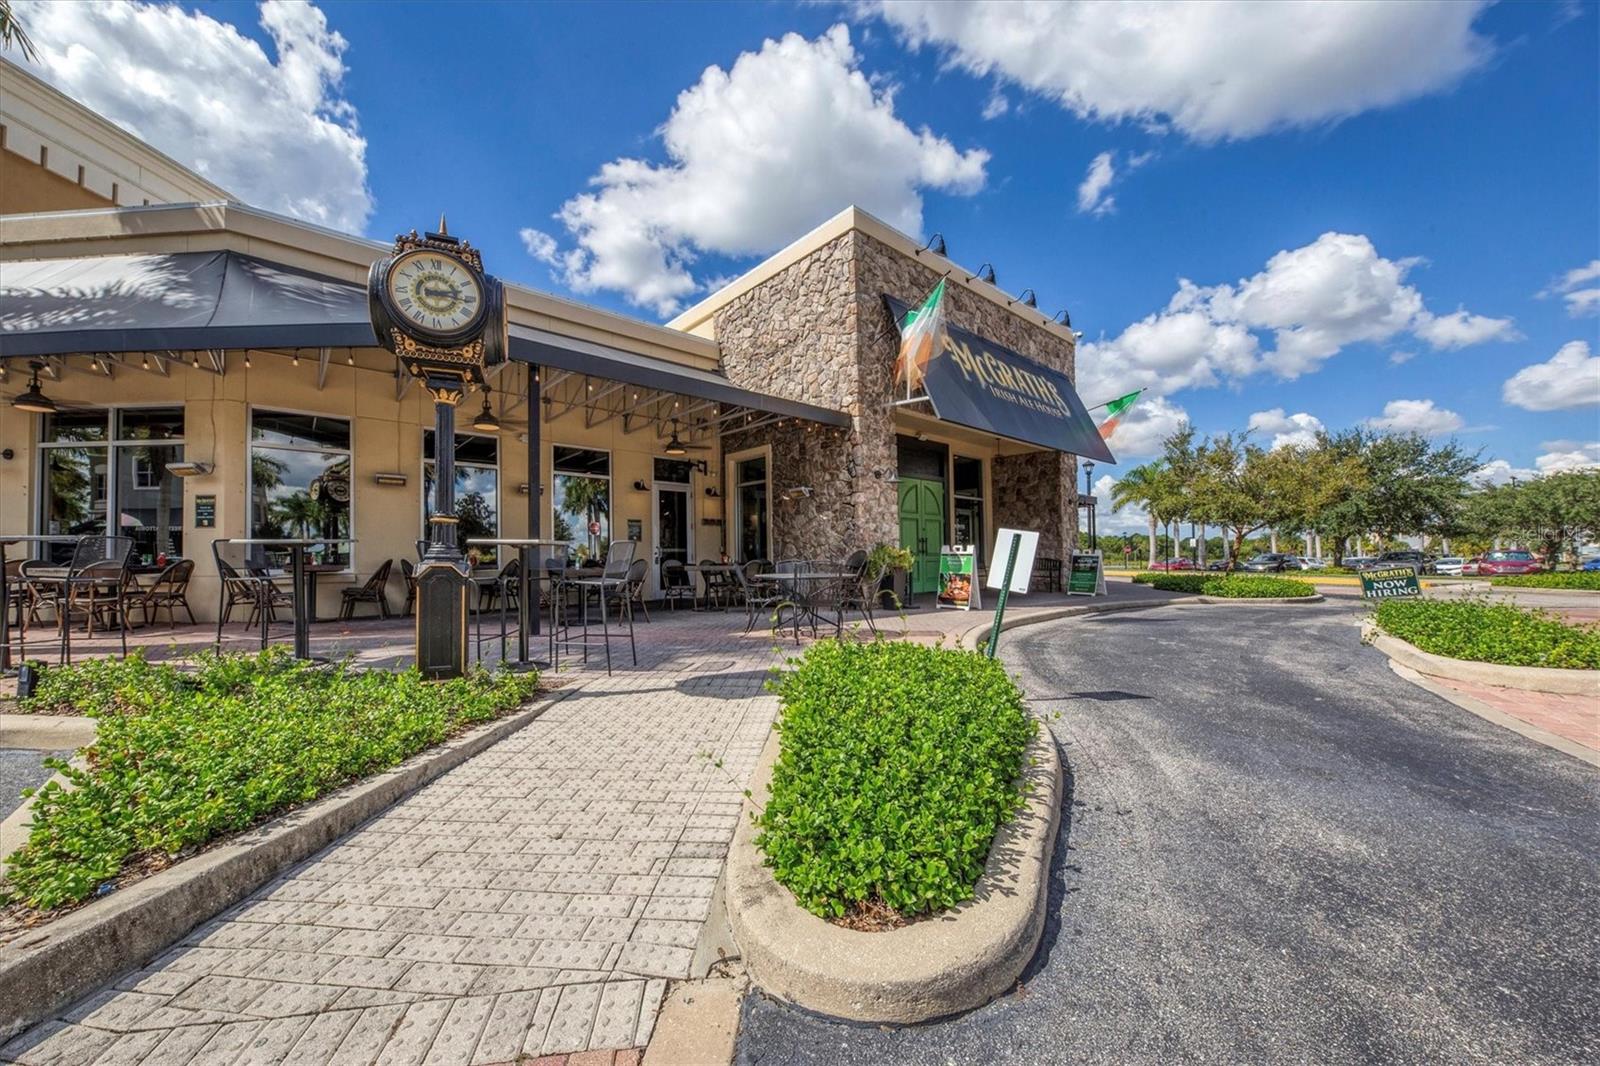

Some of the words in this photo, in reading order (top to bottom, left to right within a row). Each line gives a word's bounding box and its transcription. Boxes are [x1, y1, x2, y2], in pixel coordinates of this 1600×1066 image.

[989, 384, 1018, 404] IRISH
[1373, 580, 1407, 590] NOW
[1366, 586, 1418, 598] HIRING
